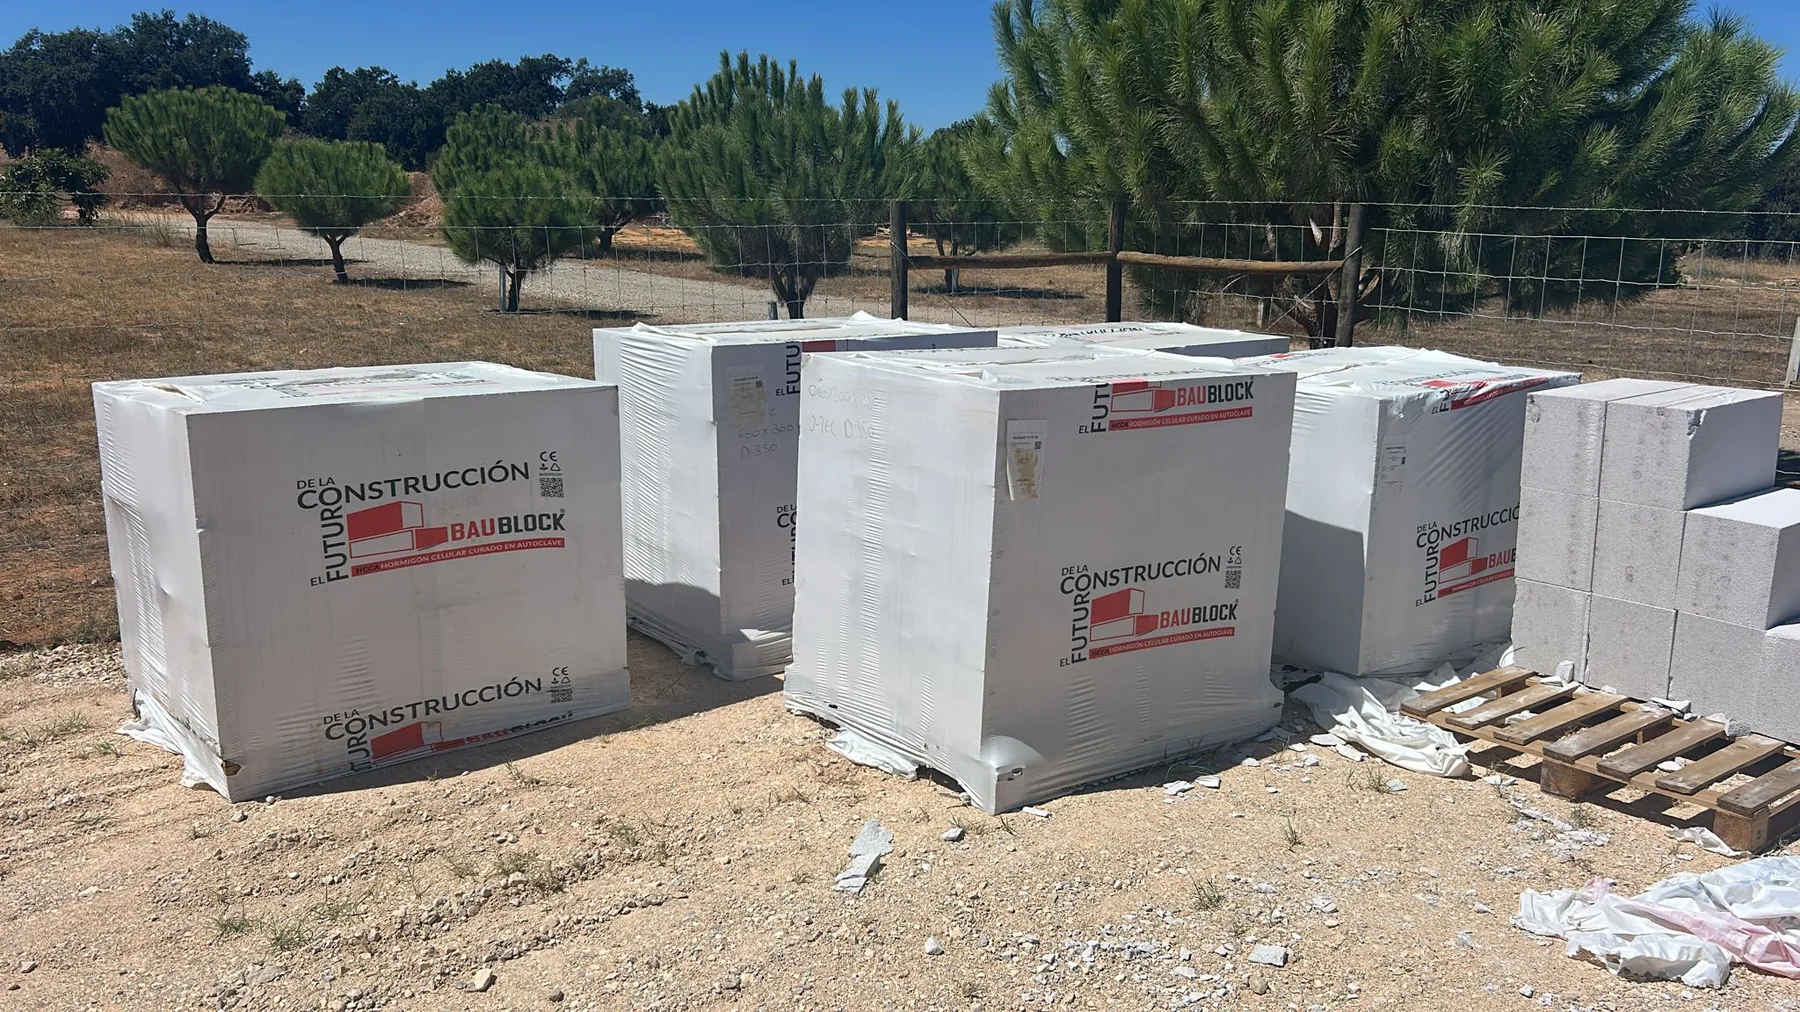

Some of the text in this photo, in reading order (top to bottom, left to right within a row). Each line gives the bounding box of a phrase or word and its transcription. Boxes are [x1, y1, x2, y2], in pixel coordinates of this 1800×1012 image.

[775, 388, 786, 396] EL
[1176, 381, 1254, 407] BAUBLOCK
[1162, 416, 1186, 425] CELULAR
[1186, 413, 1210, 423] CURADO
[1219, 409, 1251, 418] AUTOCLAVE
[1078, 424, 1089, 434] EL
[296, 476, 336, 490] DE LA
[297, 460, 530, 510] CONSTRUCCIÓN
[776, 504, 789, 513] DE
[450, 512, 566, 542] BAUBLOCK
[1417, 521, 1438, 533] DE LA
[355, 538, 564, 575] HCCA HORMIGÓN CELULAR CURADO EN AUTOCLAVE
[1060, 552, 1222, 595] CONSTRUCCIÓN
[1061, 564, 1089, 576] DE LA
[310, 576, 326, 587] EL
[781, 578, 792, 586] EL
[1415, 598, 1424, 607] EL
[1159, 602, 1238, 630] BAUBLOCK
[1143, 638, 1169, 648] CELULAR
[1169, 633, 1194, 643] CURADO
[1202, 628, 1234, 638] AUTOCLAVE
[1060, 657, 1071, 667] EL
[324, 676, 542, 741] CONSTRUCCIÓN
[323, 709, 360, 725] DE LA
